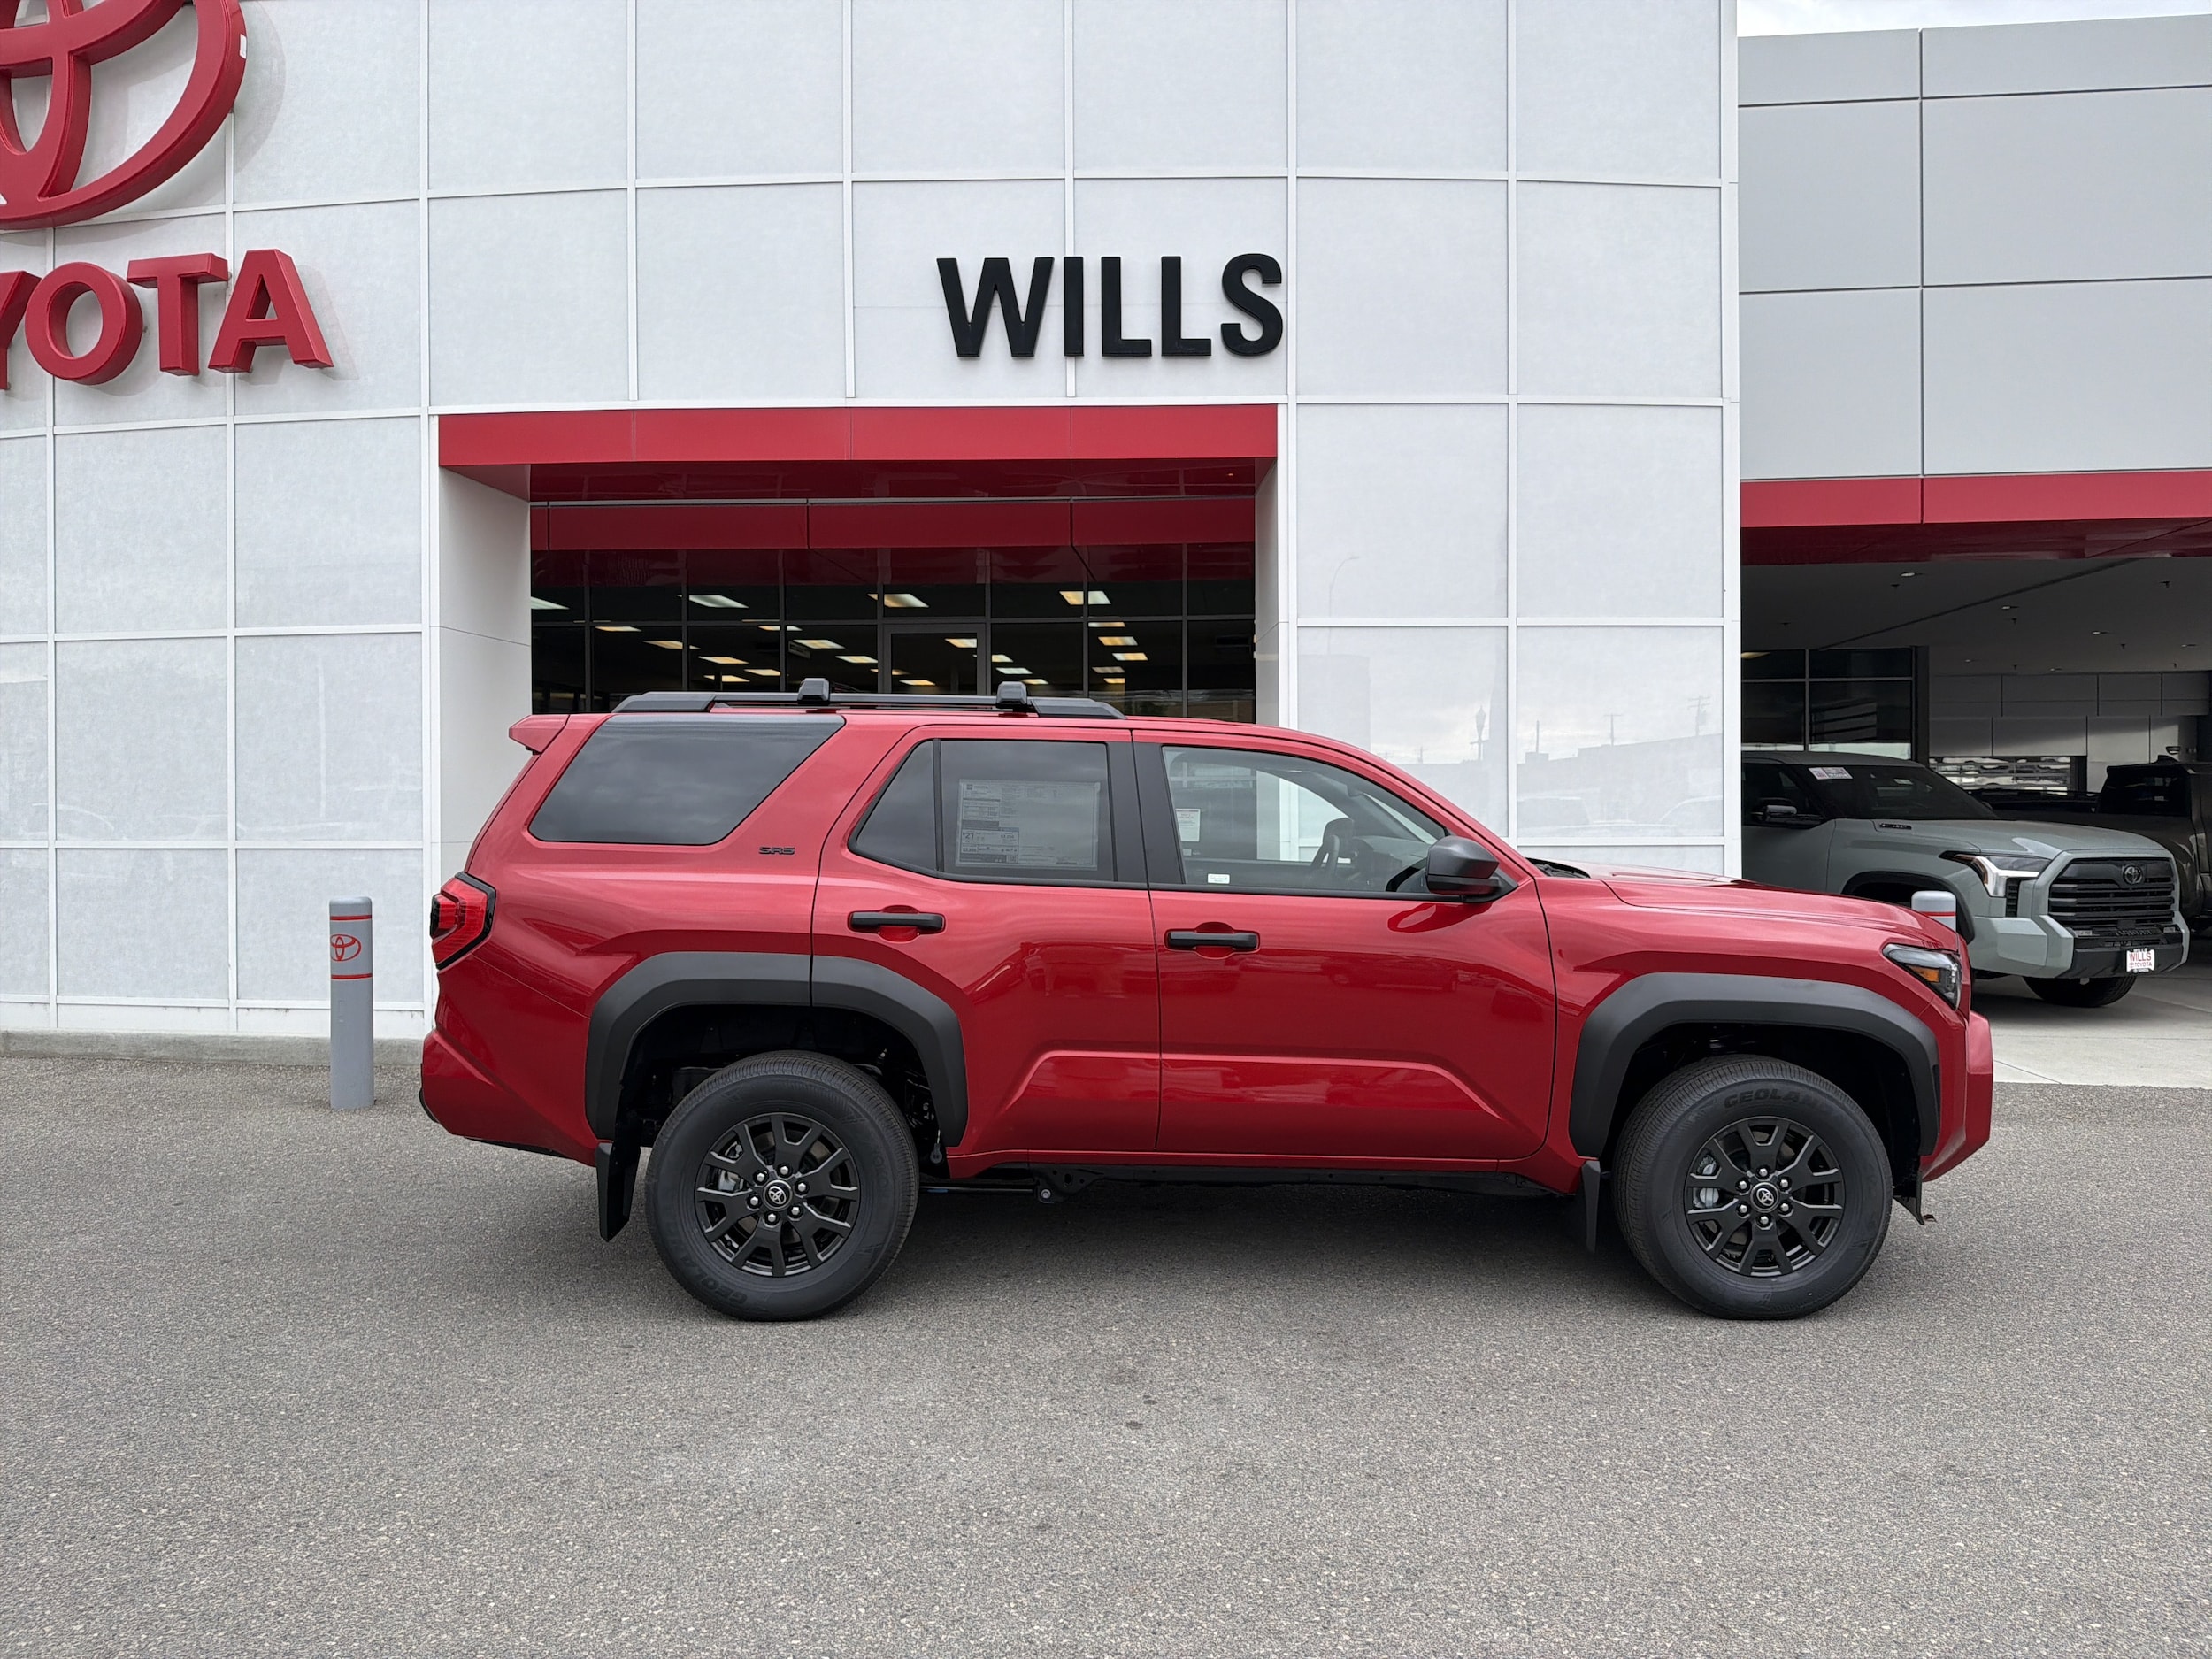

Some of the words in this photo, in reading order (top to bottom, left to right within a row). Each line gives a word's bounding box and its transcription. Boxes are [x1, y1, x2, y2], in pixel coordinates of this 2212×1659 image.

[936, 253, 1283, 357] WILLS
[758, 846, 795, 856] SR5
[2129, 952, 2152, 962] WILLS
[1724, 1087, 1807, 1109] GEOLA
